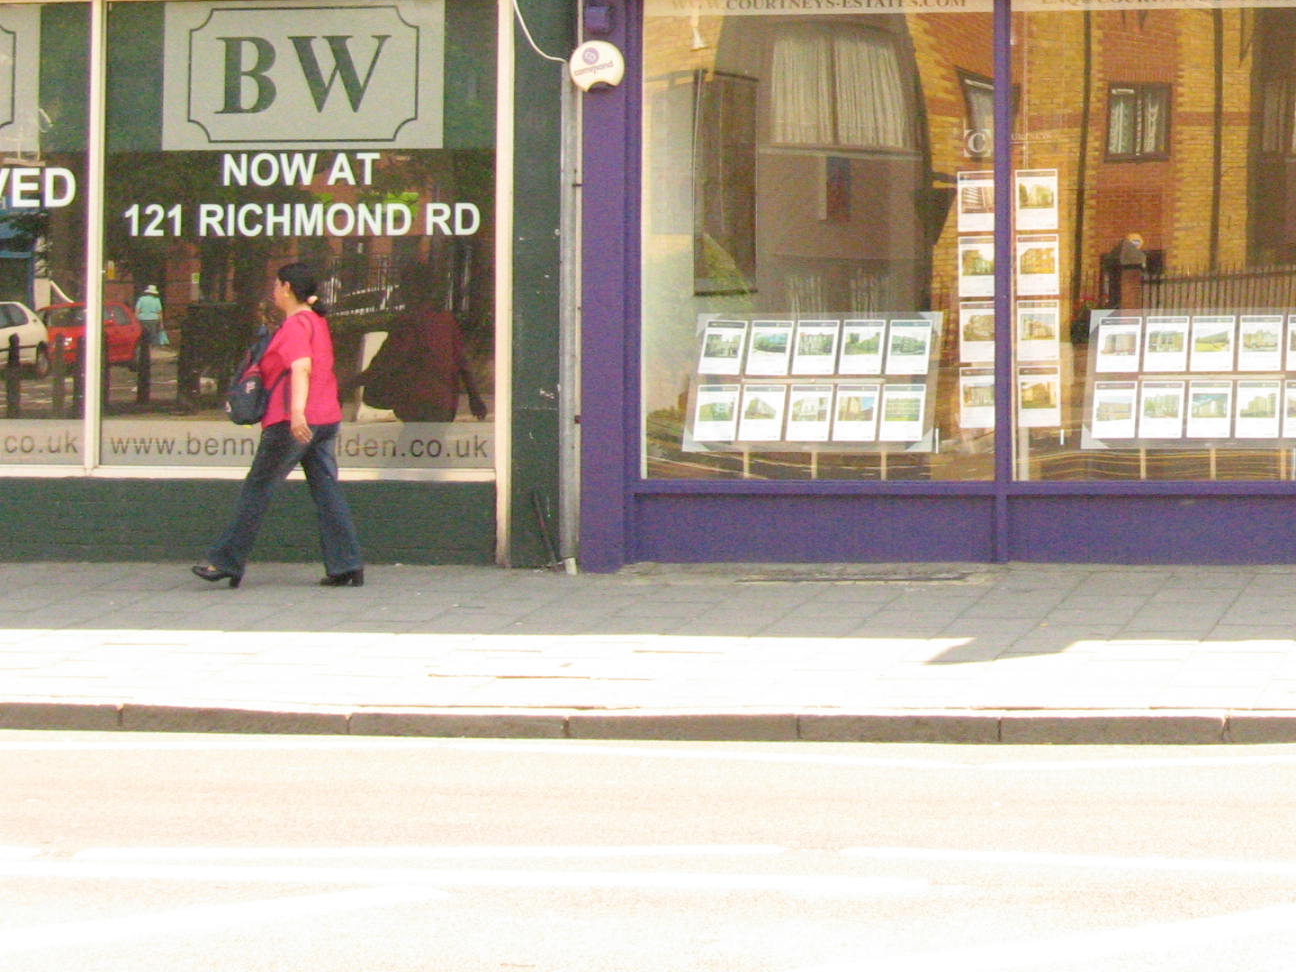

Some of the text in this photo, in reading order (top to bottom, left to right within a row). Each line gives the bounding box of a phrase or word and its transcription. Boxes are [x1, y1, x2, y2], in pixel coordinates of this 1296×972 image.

[214, 34, 391, 114] BW
[222, 153, 380, 186] NOW AT
[125, 202, 480, 237] 121 RICHMOND RD
